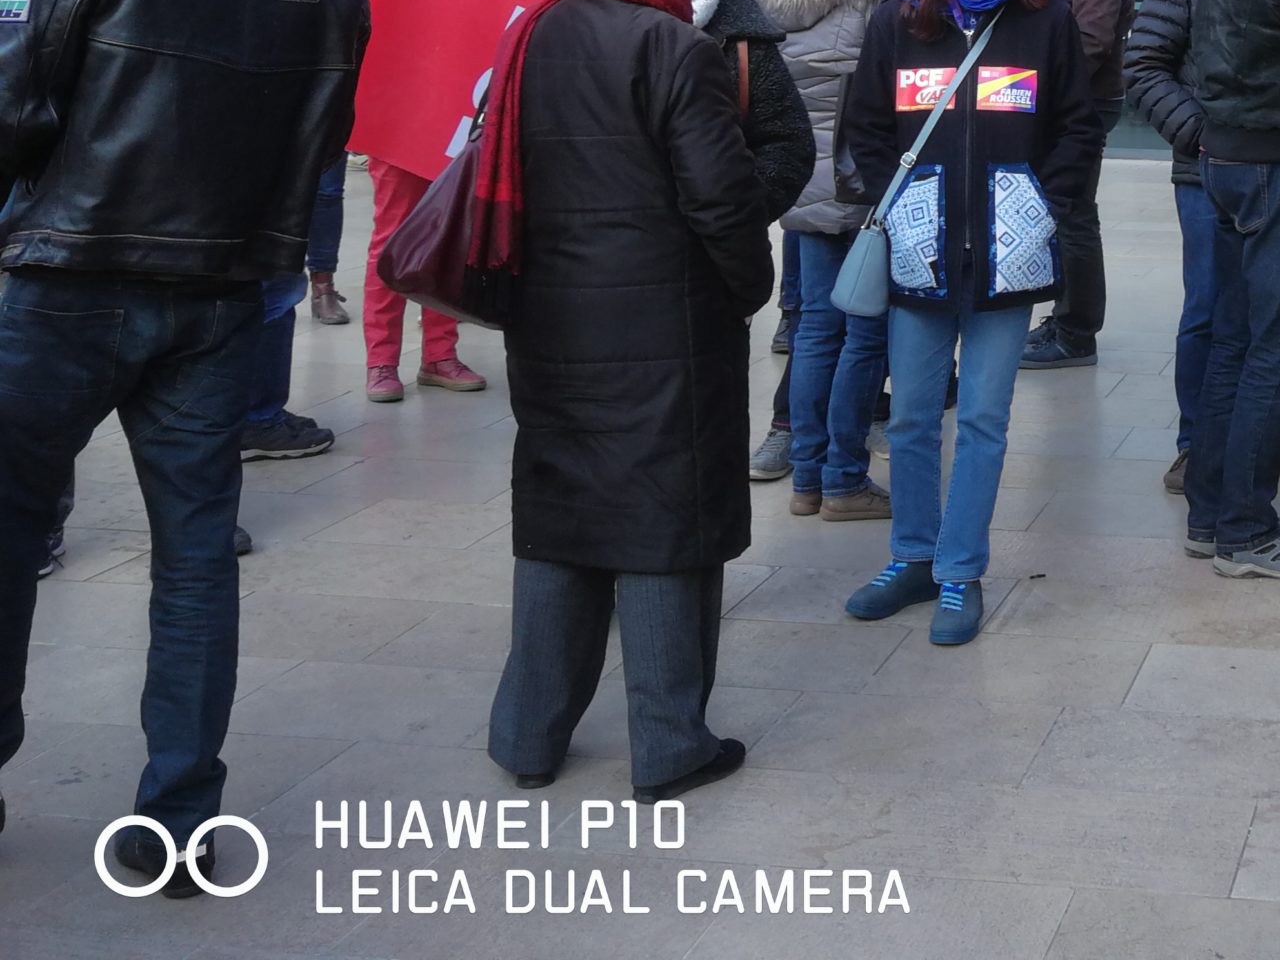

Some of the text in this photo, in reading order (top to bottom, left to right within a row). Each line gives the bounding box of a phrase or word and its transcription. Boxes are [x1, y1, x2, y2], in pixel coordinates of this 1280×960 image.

[900, 69, 944, 88] PCF
[919, 89, 947, 103] VA
[1000, 88, 1032, 97] FABIEN
[990, 94, 1032, 105] ROUSSEL
